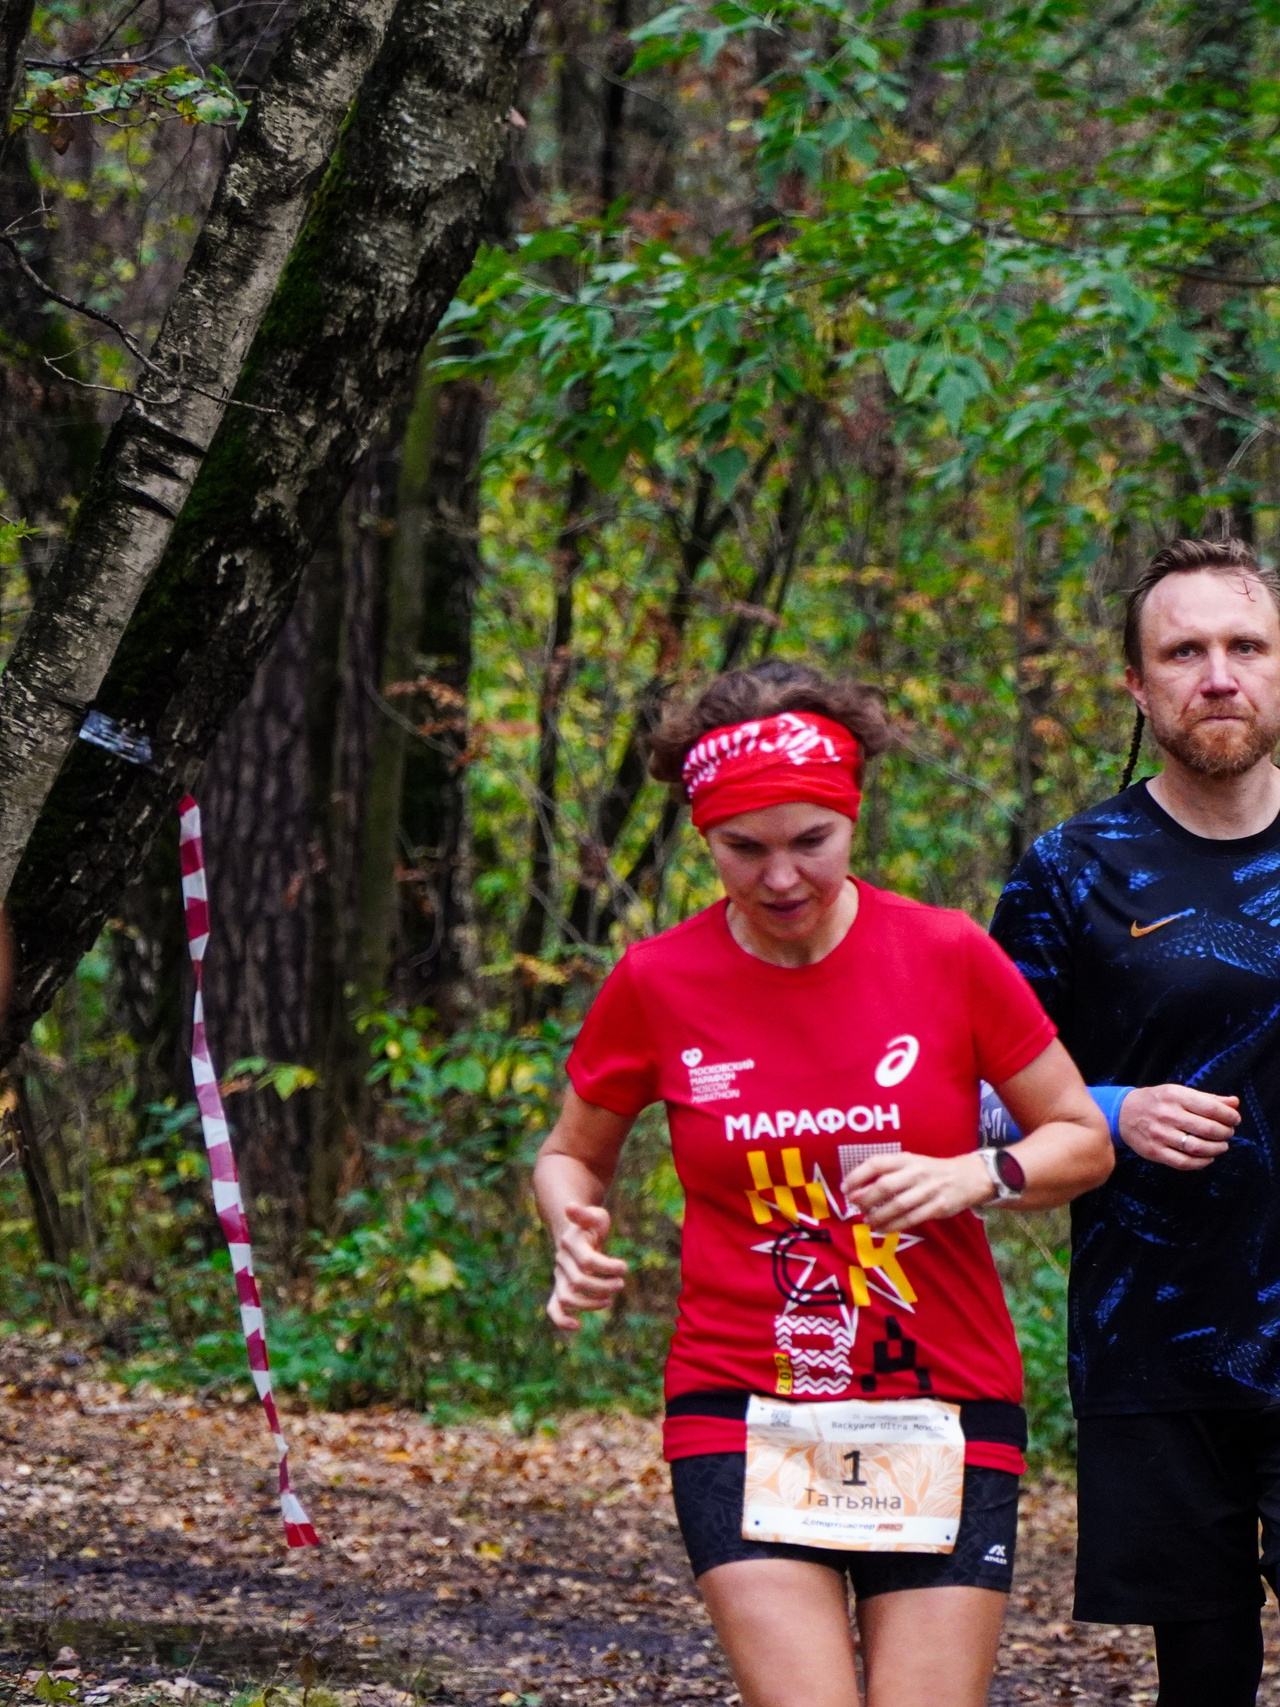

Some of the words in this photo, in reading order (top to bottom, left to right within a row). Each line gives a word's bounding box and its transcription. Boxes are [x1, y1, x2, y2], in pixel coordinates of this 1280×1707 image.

[688, 1058, 755, 1076] МОСКОВСКИЙ
[690, 1072, 736, 1086] МАРАФОН
[691, 1089, 740, 1103] MARATHON
[725, 1103, 901, 1141] МАРАФОН
[831, 1421, 876, 1431] Backyard
[880, 1422, 908, 1430] Ultra
[842, 1450, 867, 1487] 1
[804, 1488, 902, 1510] Татьяна
[876, 1522, 903, 1531] PRO
